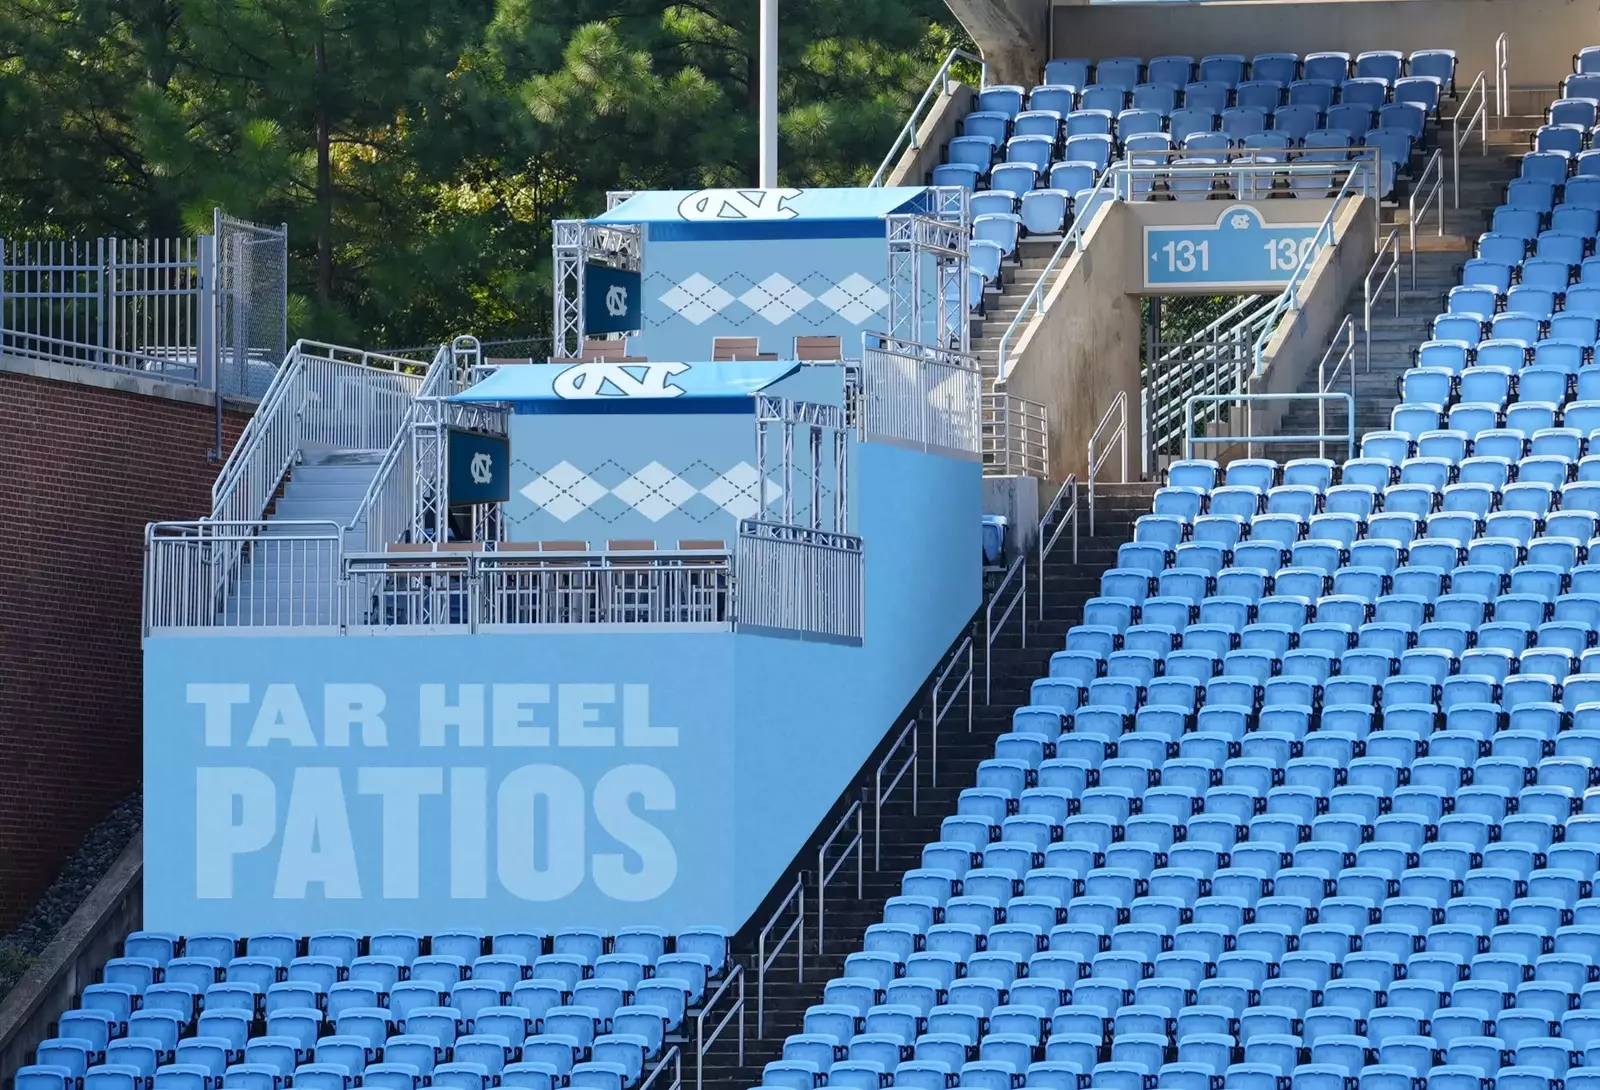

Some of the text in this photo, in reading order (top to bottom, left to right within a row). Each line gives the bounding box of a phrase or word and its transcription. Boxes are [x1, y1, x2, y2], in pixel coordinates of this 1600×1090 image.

[1162, 240, 1209, 272] 131
[186, 683, 679, 747] TAR HEEL
[196, 763, 678, 902] PATIOS
